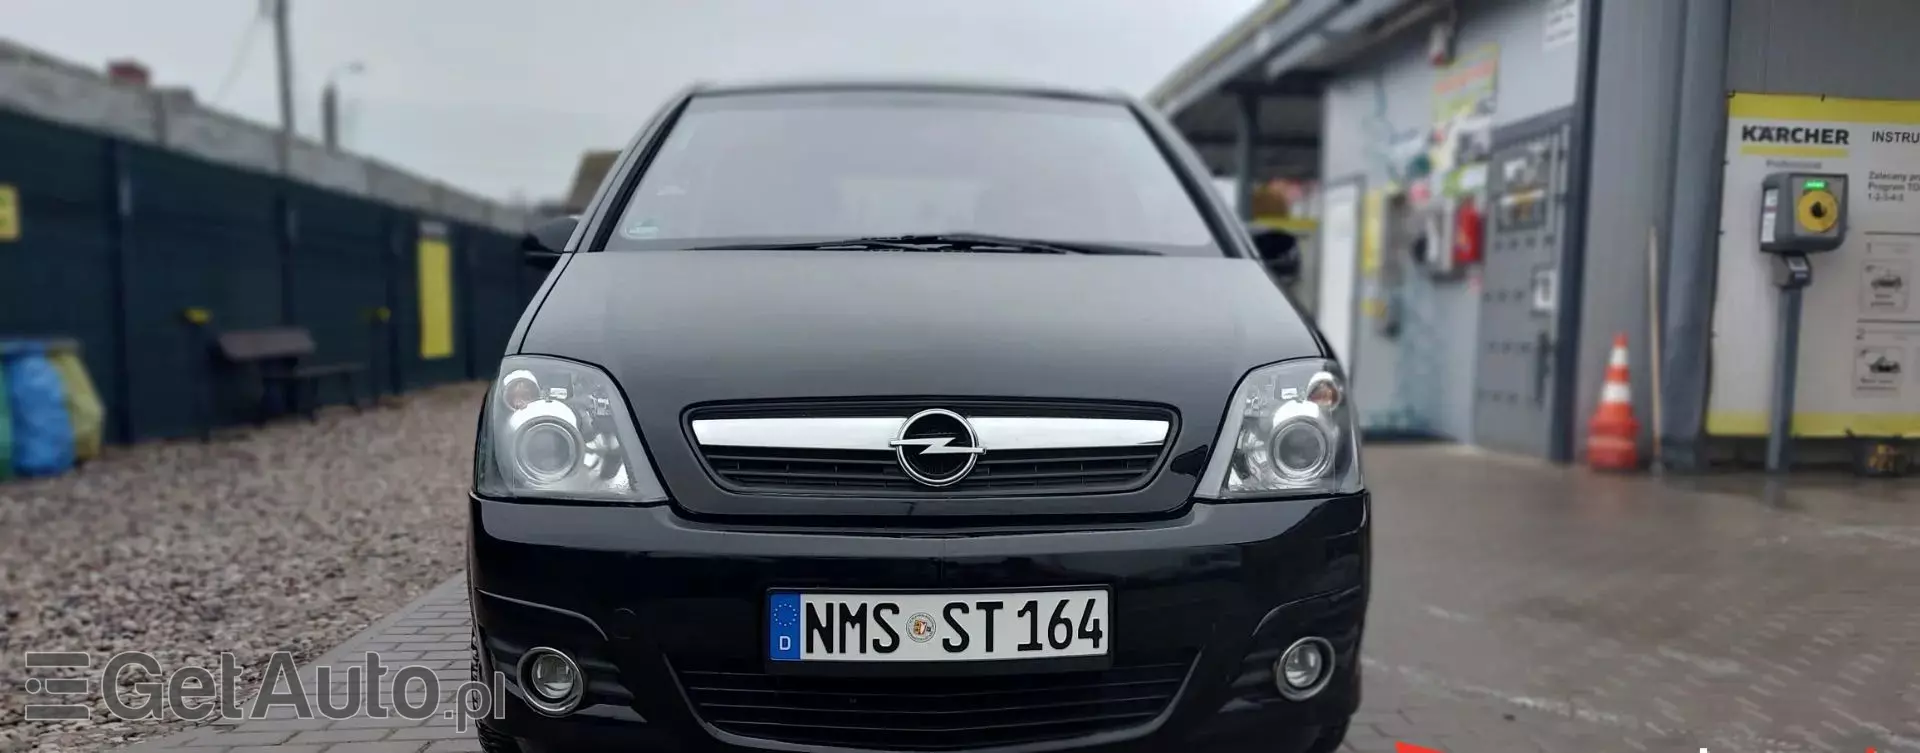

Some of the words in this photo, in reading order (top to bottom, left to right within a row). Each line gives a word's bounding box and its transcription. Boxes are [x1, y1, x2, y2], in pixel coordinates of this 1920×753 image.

[1741, 125, 1850, 145] KÄRCHER
[805, 602, 900, 654] NMS
[942, 601, 1004, 653] ST
[1017, 598, 1103, 651] 164
[779, 636, 791, 651] D
